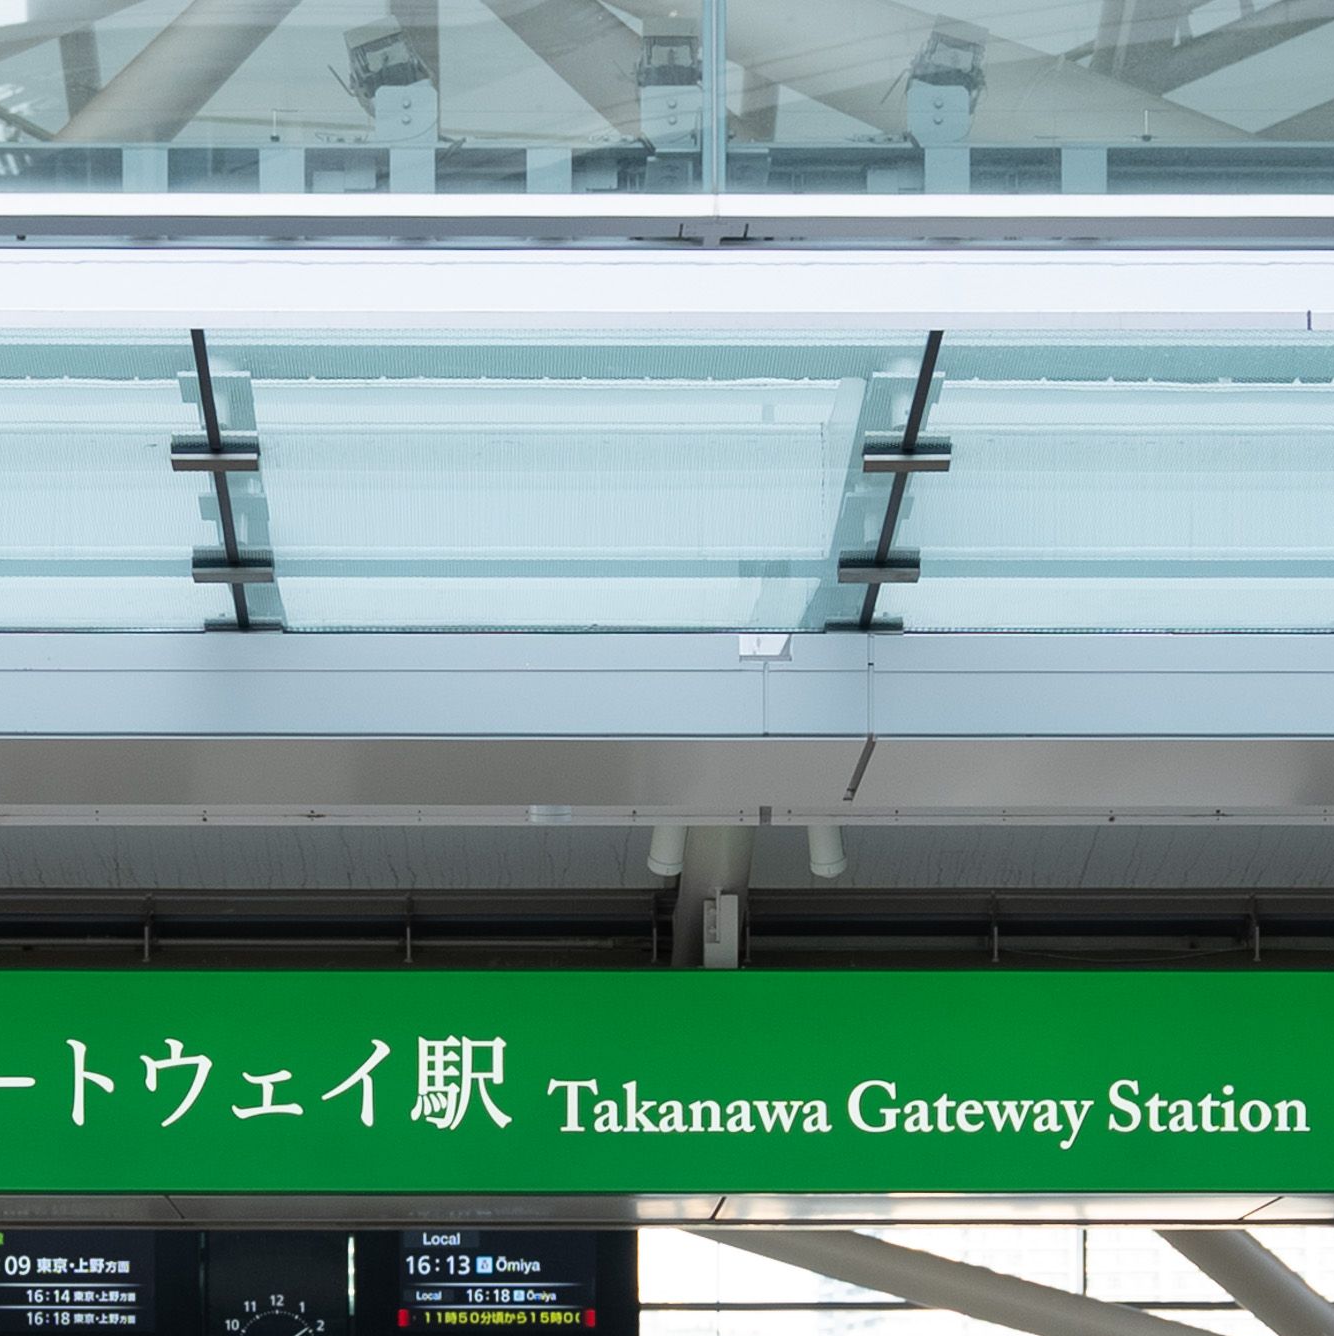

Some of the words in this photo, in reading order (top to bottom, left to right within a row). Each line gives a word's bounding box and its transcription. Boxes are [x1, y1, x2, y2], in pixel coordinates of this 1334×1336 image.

[548, 1078, 832, 1133] Takanawa
[848, 1078, 1094, 1150] Gateway
[1109, 1078, 1310, 1133] Station
[423, 1233, 461, 1246] Local
[406, 1255, 471, 1275] 16:13
[26, 1289, 70, 1303] 16:14
[270, 1294, 284, 1307] 12
[416, 1291, 442, 1301] Local
[466, 1289, 510, 1303] 16:18
[244, 1301, 256, 1312] 11
[299, 1301, 305, 1313] 1
[26, 1312, 70, 1325] 16:18
[226, 1319, 239, 1331] 10
[316, 1320, 325, 1332] 2
